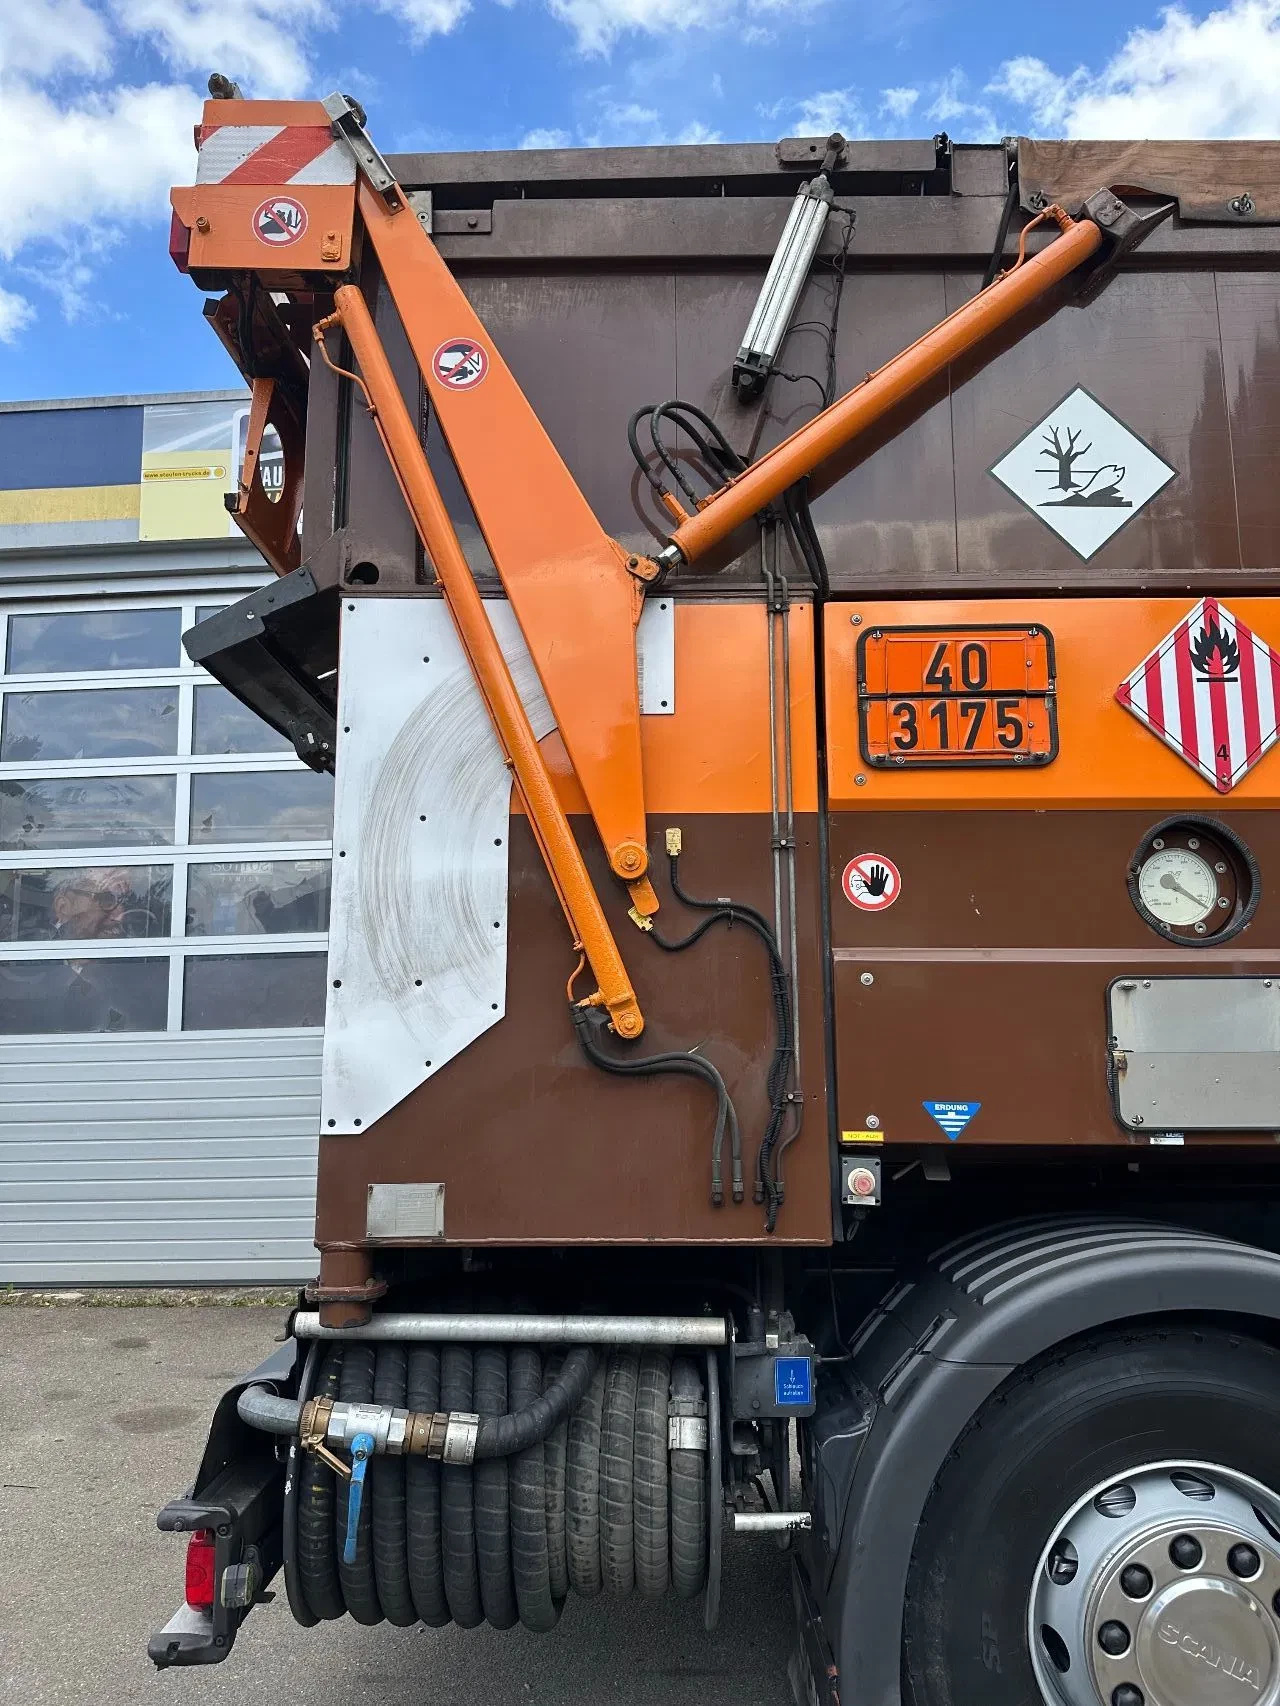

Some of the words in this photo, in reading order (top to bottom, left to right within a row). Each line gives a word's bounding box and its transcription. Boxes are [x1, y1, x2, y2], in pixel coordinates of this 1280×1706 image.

[925, 643, 988, 692] 40
[892, 700, 1023, 751] 3175
[1216, 744, 1230, 761] 4
[934, 1103, 969, 1111] ERDUNG
[1157, 1623, 1261, 1691] SCANIA
